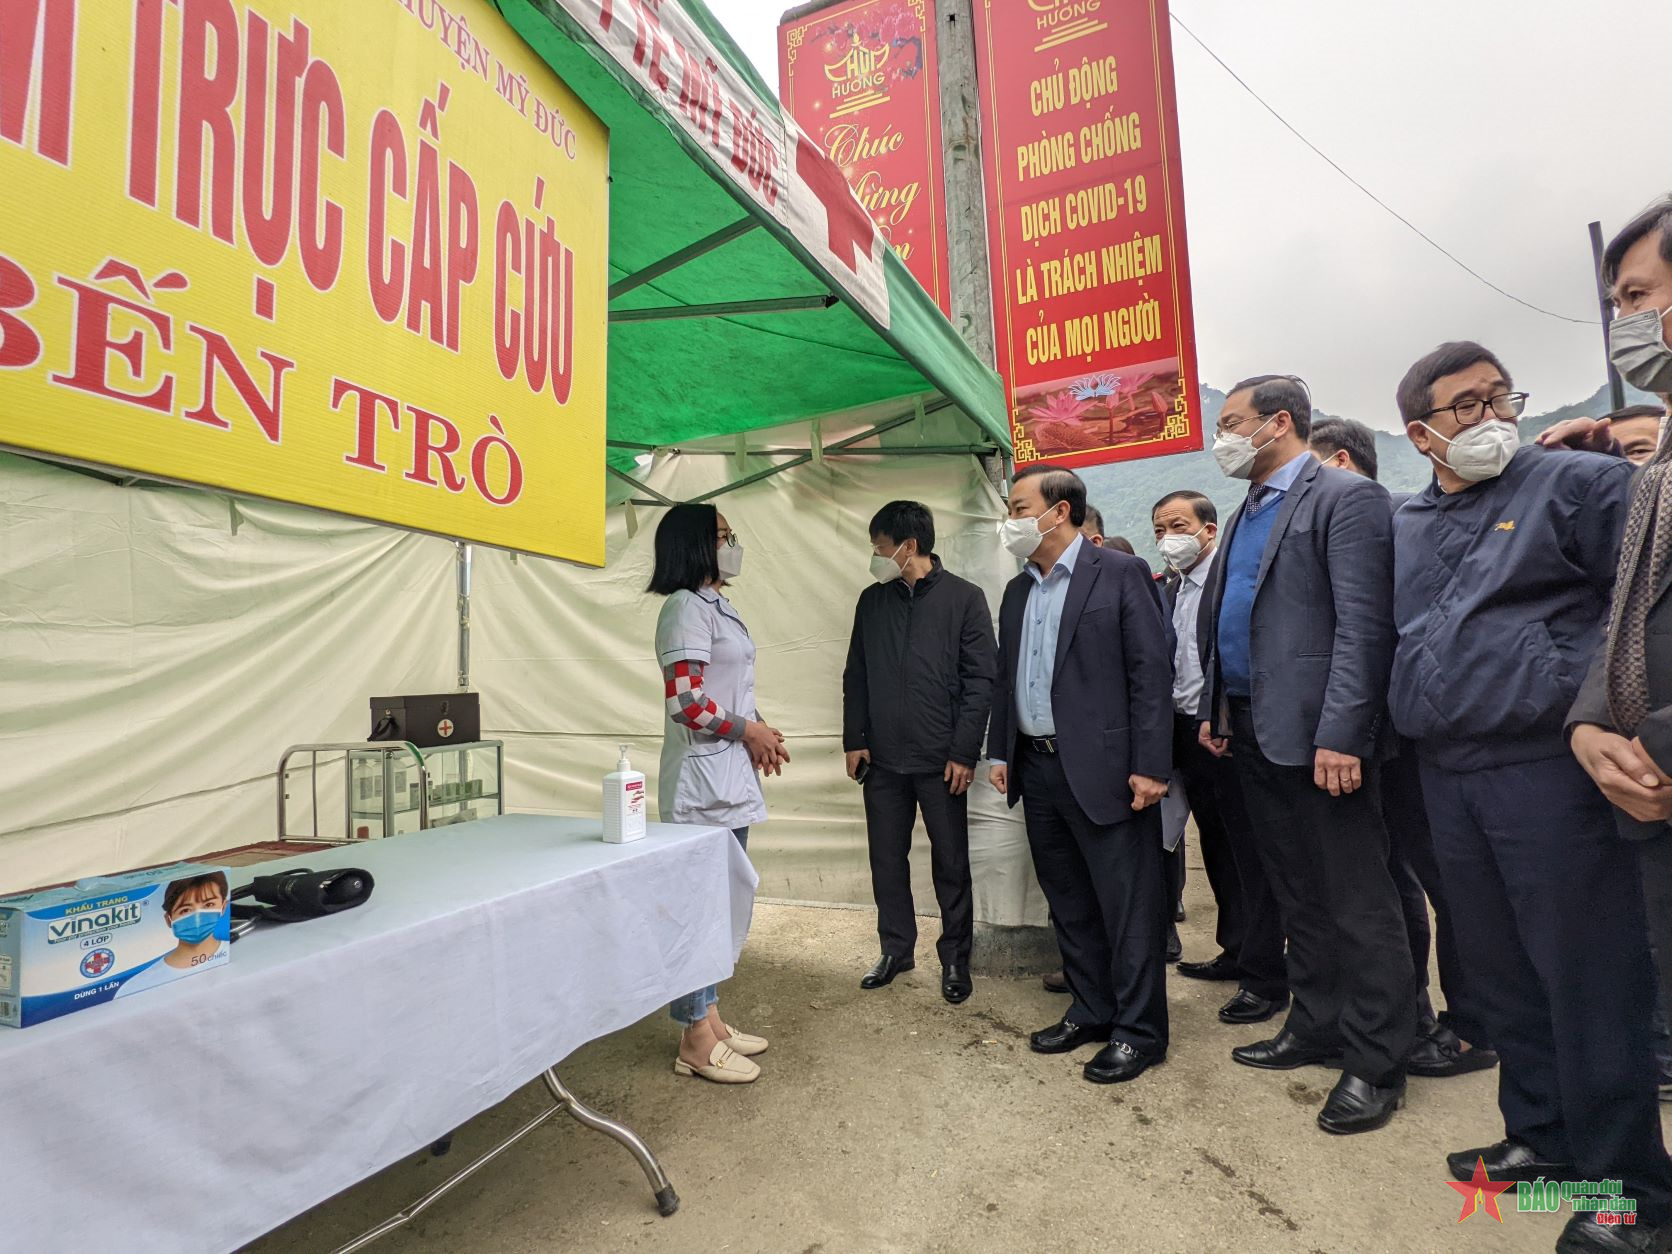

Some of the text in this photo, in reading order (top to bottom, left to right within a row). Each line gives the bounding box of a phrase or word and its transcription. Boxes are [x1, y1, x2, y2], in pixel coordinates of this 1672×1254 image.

[495, 60, 530, 118] MỸ
[534, 97, 577, 160] ĐỨC
[1030, 55, 1118, 117] CHỦ ĐỘNG
[728, 97, 778, 208] ĐỨC
[824, 124, 905, 168] Chúc
[1017, 105, 1142, 182] PHÒNG CHỐNG
[366, 81, 480, 355] CẤP
[494, 175, 575, 406] CỨU
[1020, 175, 1147, 247] DỊCH COVID-19
[1016, 231, 1163, 305] LÀ TRÁCH NHIỆM
[1026, 292, 1162, 366] CỦA MỌI NGƯỜI
[331, 378, 525, 506] TRÒ
[50, 903, 139, 937] vinakit
[96, 896, 128, 908] TRANG
[191, 953, 206, 966] 50
